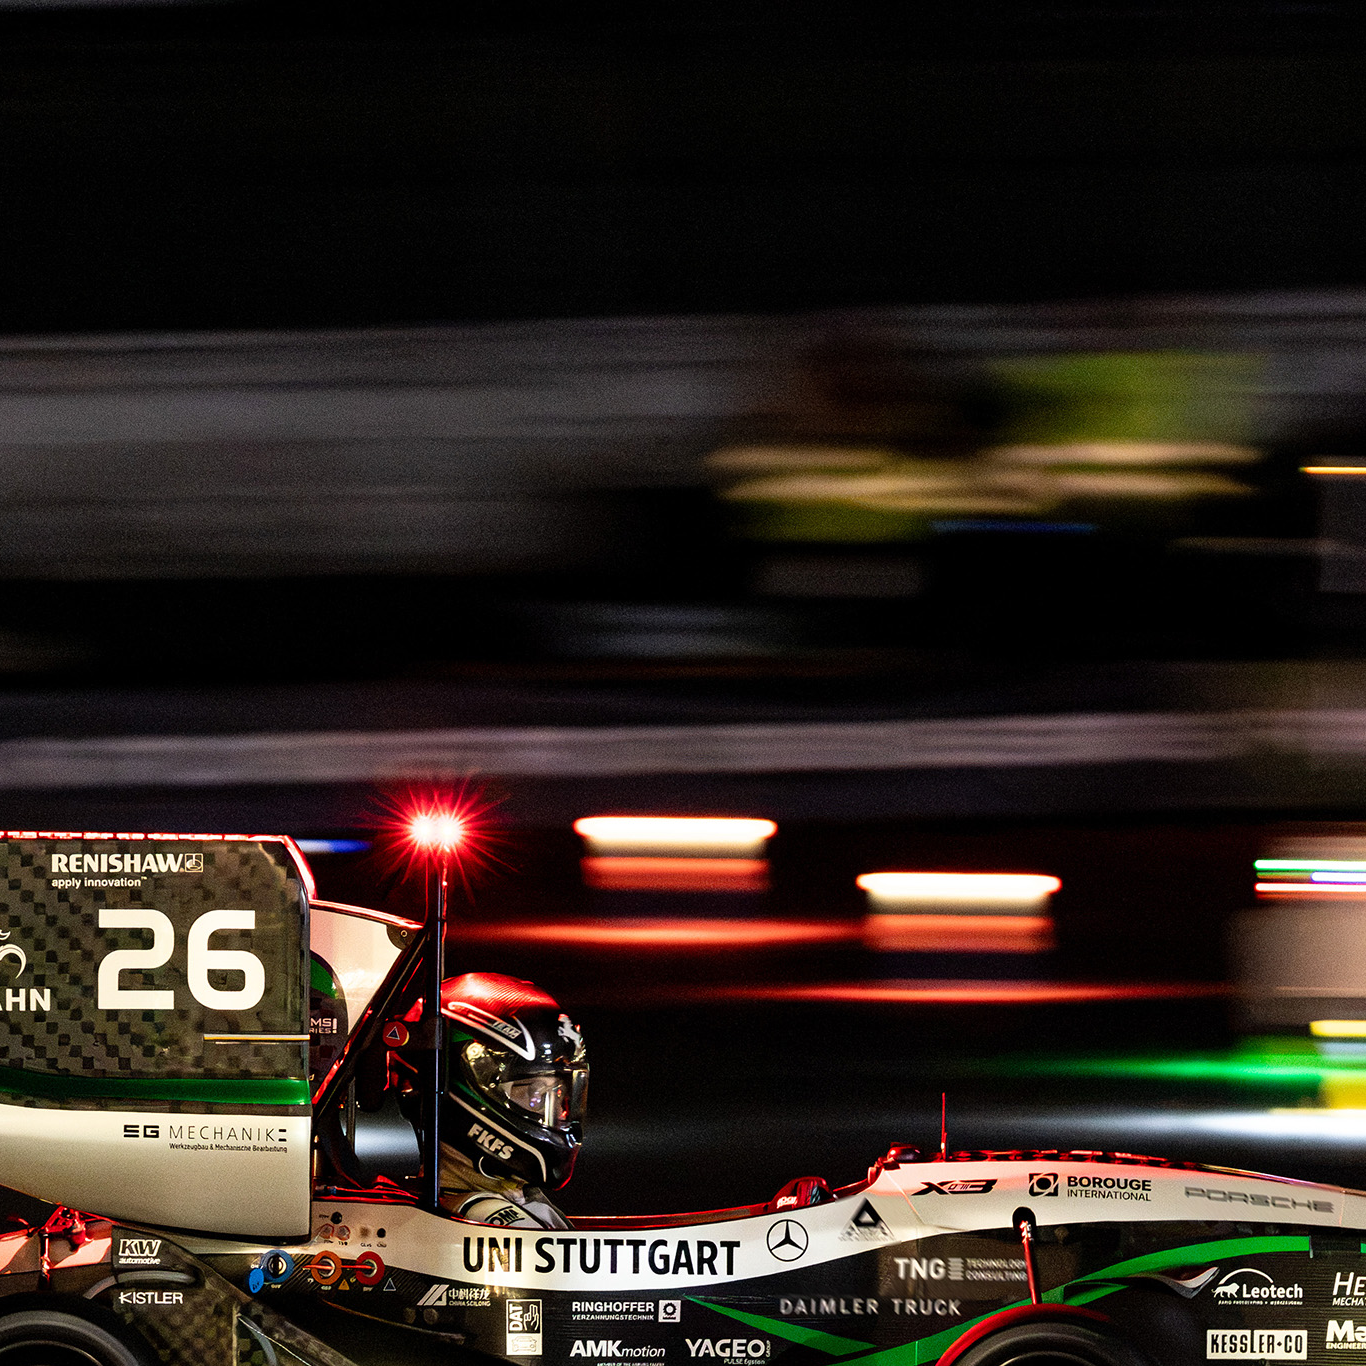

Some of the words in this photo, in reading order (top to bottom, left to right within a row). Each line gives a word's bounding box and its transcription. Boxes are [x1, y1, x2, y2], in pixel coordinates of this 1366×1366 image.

[51, 878, 82, 889] apply
[97, 909, 266, 1011] 26
[169, 1125, 275, 1141] MECHANIK
[467, 1123, 514, 1160] FKFS
[169, 1143, 209, 1151] Werkzeugbau
[215, 1144, 252, 1152] Mechanische
[253, 1145, 287, 1153] Bearbeitung
[1067, 1176, 1152, 1191] BOROUGE
[1067, 1189, 1151, 1202] INTERNATIONAL
[1185, 1186, 1334, 1213] PORSCHE
[118, 1238, 162, 1257] KW
[118, 1257, 161, 1265] automotive
[462, 1237, 523, 1273] UNI
[534, 1237, 741, 1276] STUTTGART
[893, 1257, 946, 1280] TNG
[118, 1292, 183, 1305] KISTLER
[1242, 1283, 1303, 1299] Leotech
[571, 1302, 654, 1312] RINGHOFFER
[779, 1298, 879, 1315] DAIMLER
[892, 1298, 962, 1317] TRUCK
[508, 1303, 523, 1331] DAT
[685, 1338, 765, 1358] YAGEO
